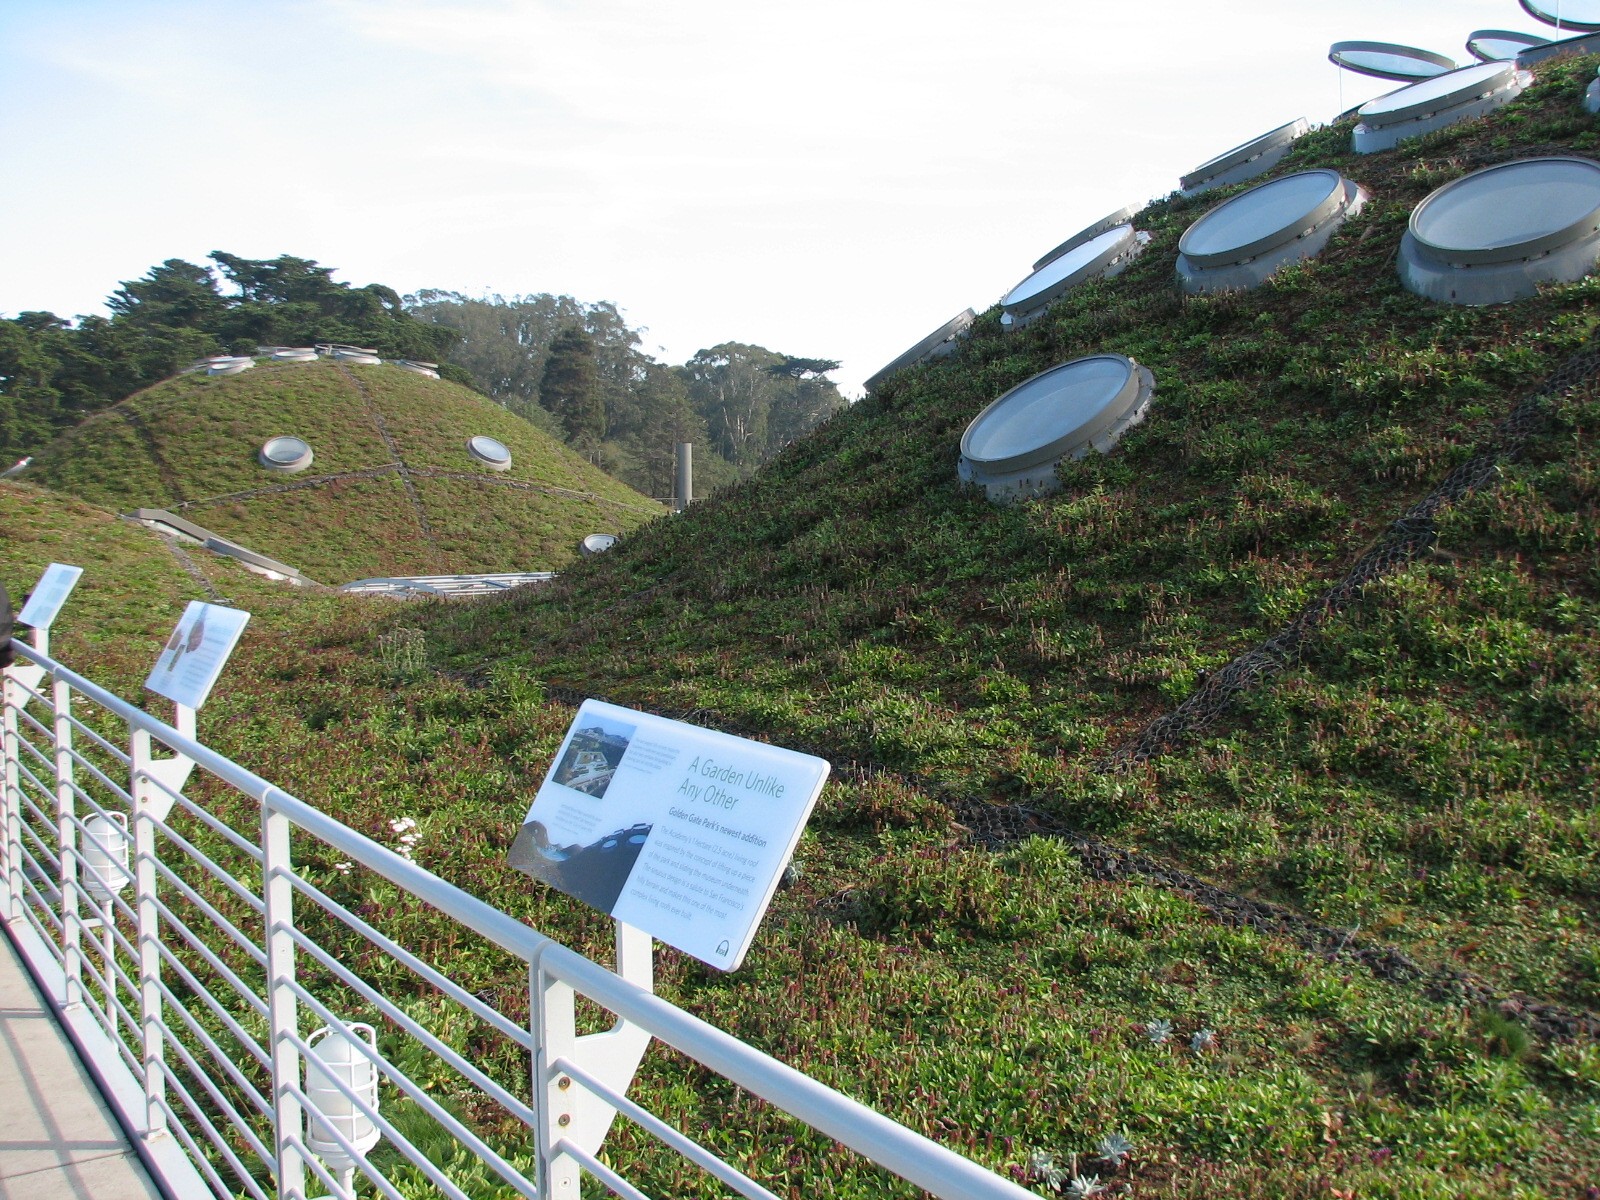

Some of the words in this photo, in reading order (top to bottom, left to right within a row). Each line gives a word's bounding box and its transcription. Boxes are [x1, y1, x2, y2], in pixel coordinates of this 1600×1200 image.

[677, 777, 705, 804] Any
[703, 784, 740, 812] Other
[687, 755, 701, 773] A
[701, 758, 745, 787] Garden
[744, 771, 786, 799] Unlike
[668, 806, 689, 820] Golden
[687, 811, 705, 826] Gate
[701, 817, 721, 832] Park's
[719, 824, 742, 839] newest
[739, 830, 767, 848] addition
